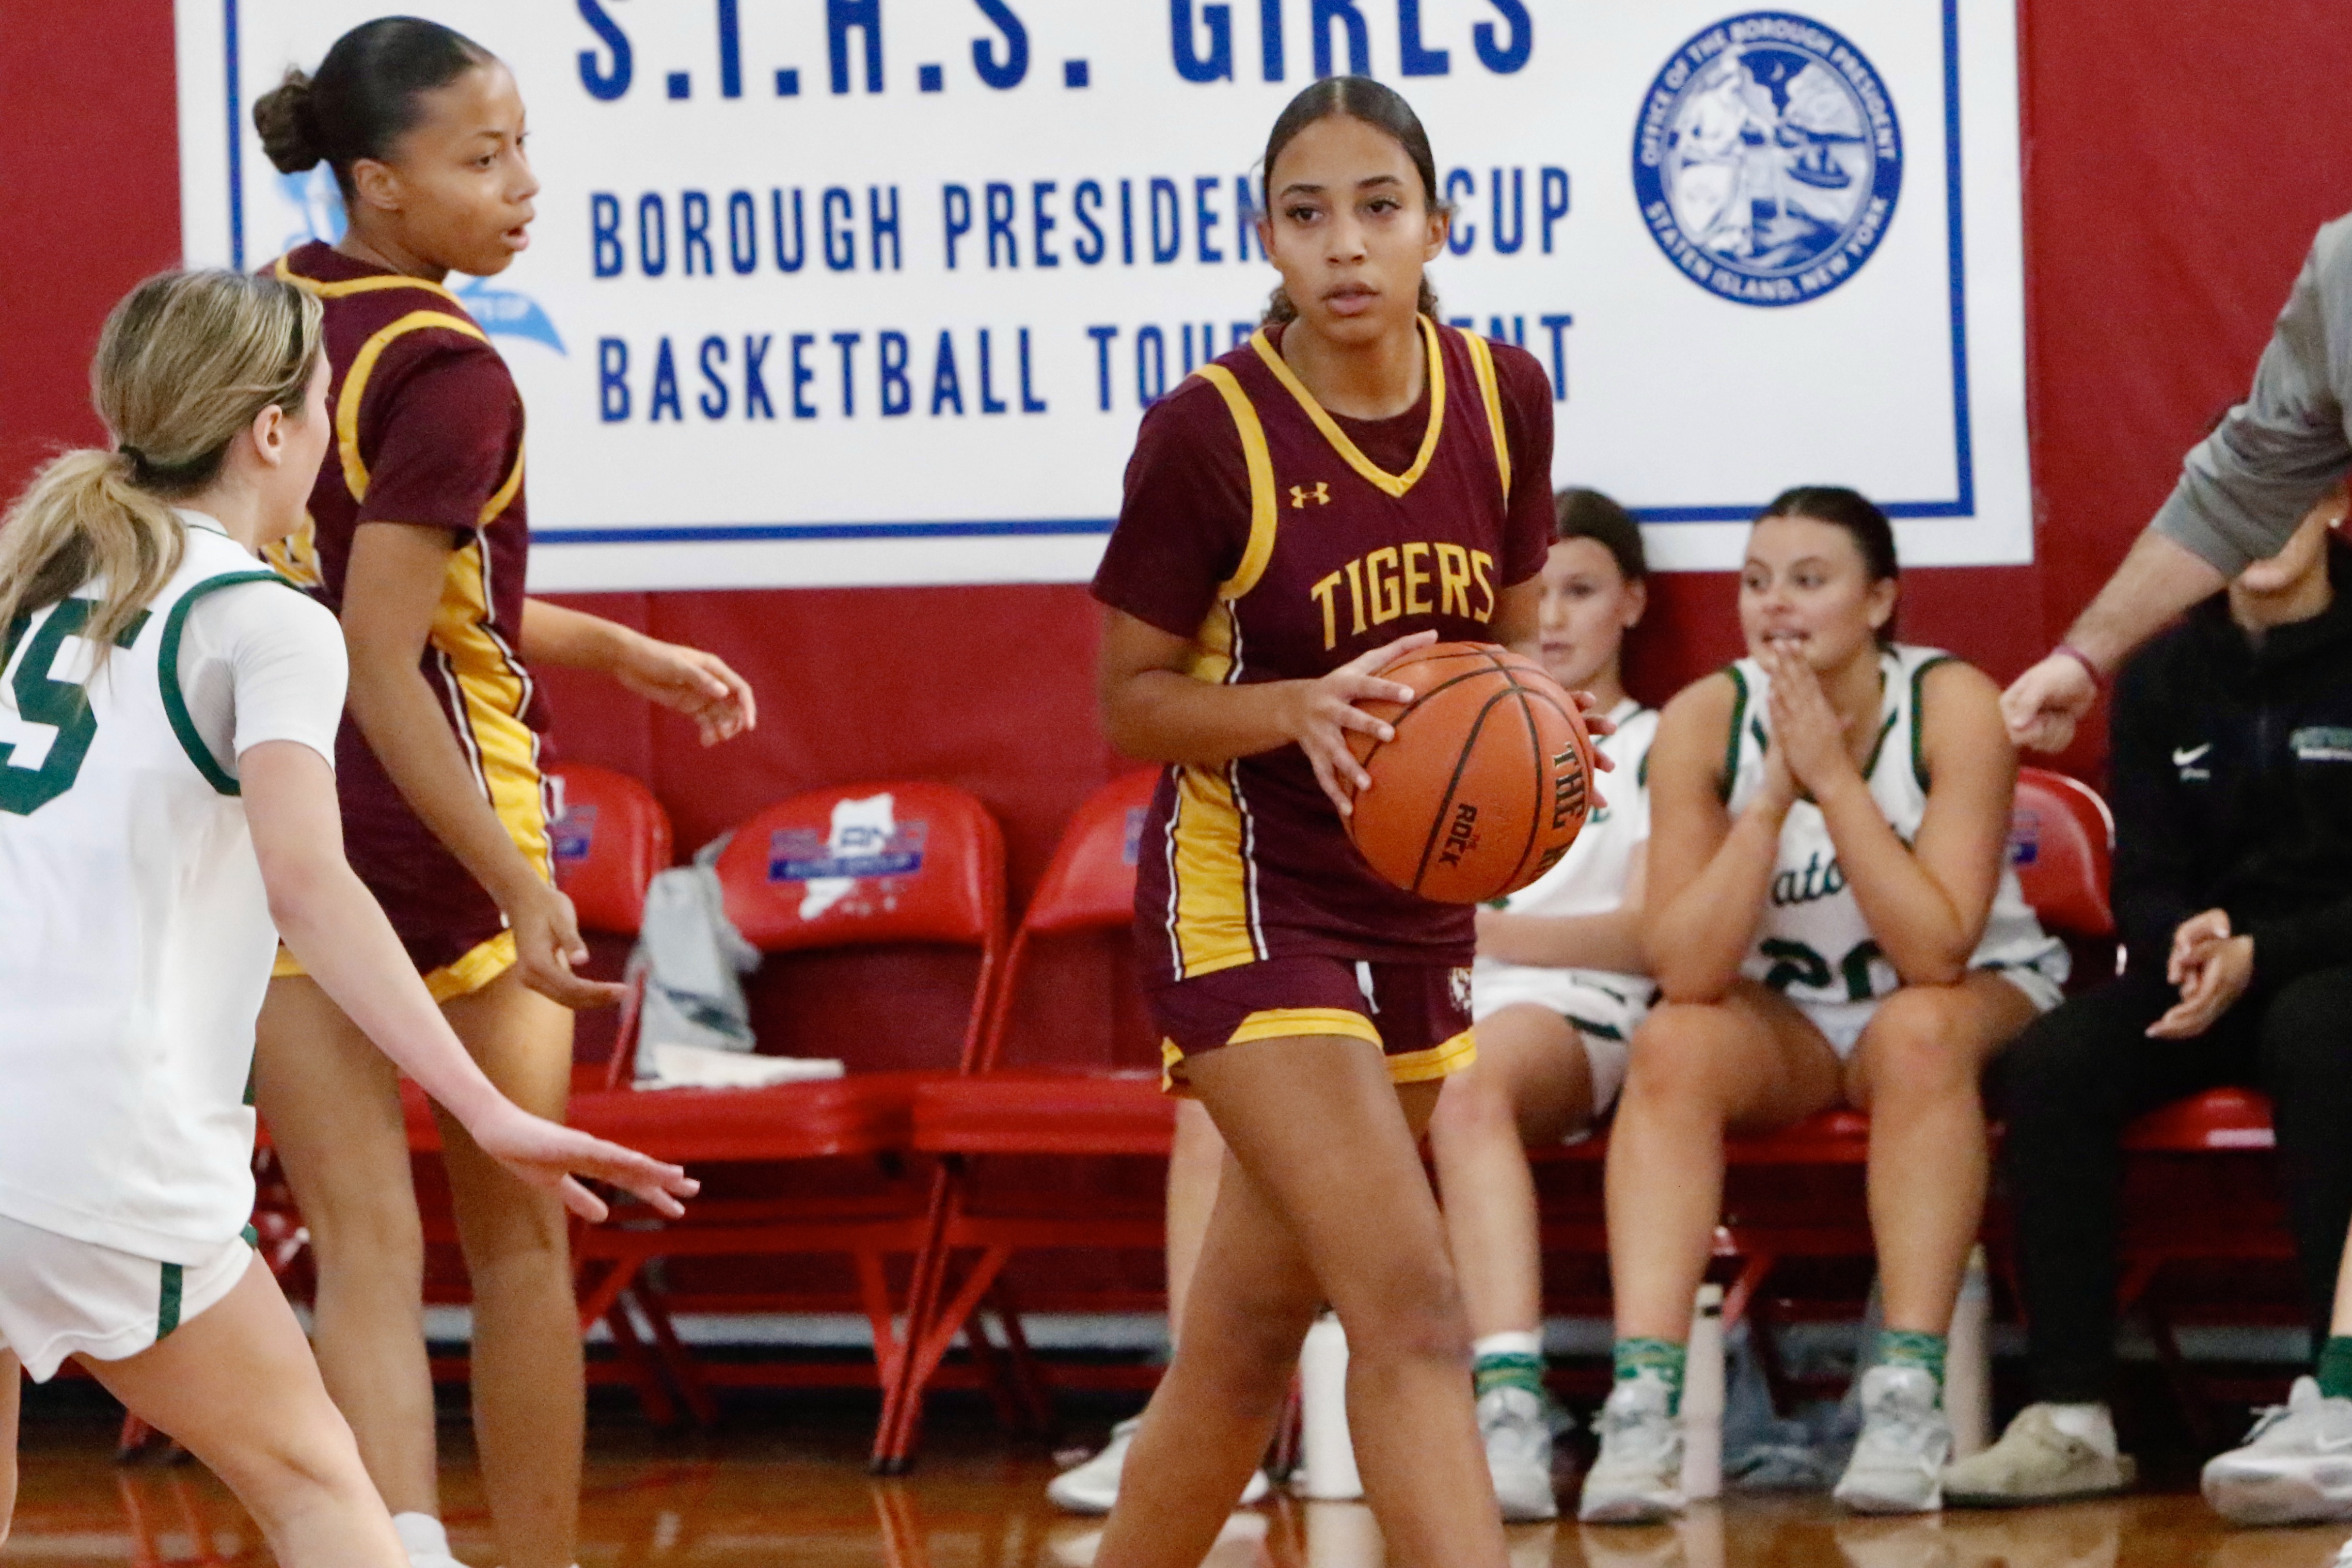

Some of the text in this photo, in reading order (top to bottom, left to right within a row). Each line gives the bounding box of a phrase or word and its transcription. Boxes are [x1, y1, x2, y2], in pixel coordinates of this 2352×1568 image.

[590, 167, 1571, 279] BOROUGH PRESIDEN CUP
[599, 327, 1048, 422] BASKETBALL
[1311, 542, 1495, 652] TIGERS
[0, 597, 153, 817] 5
[1552, 741, 1585, 829] THE
[1438, 803, 1478, 868] ROCK
[1771, 851, 1845, 909] ato
